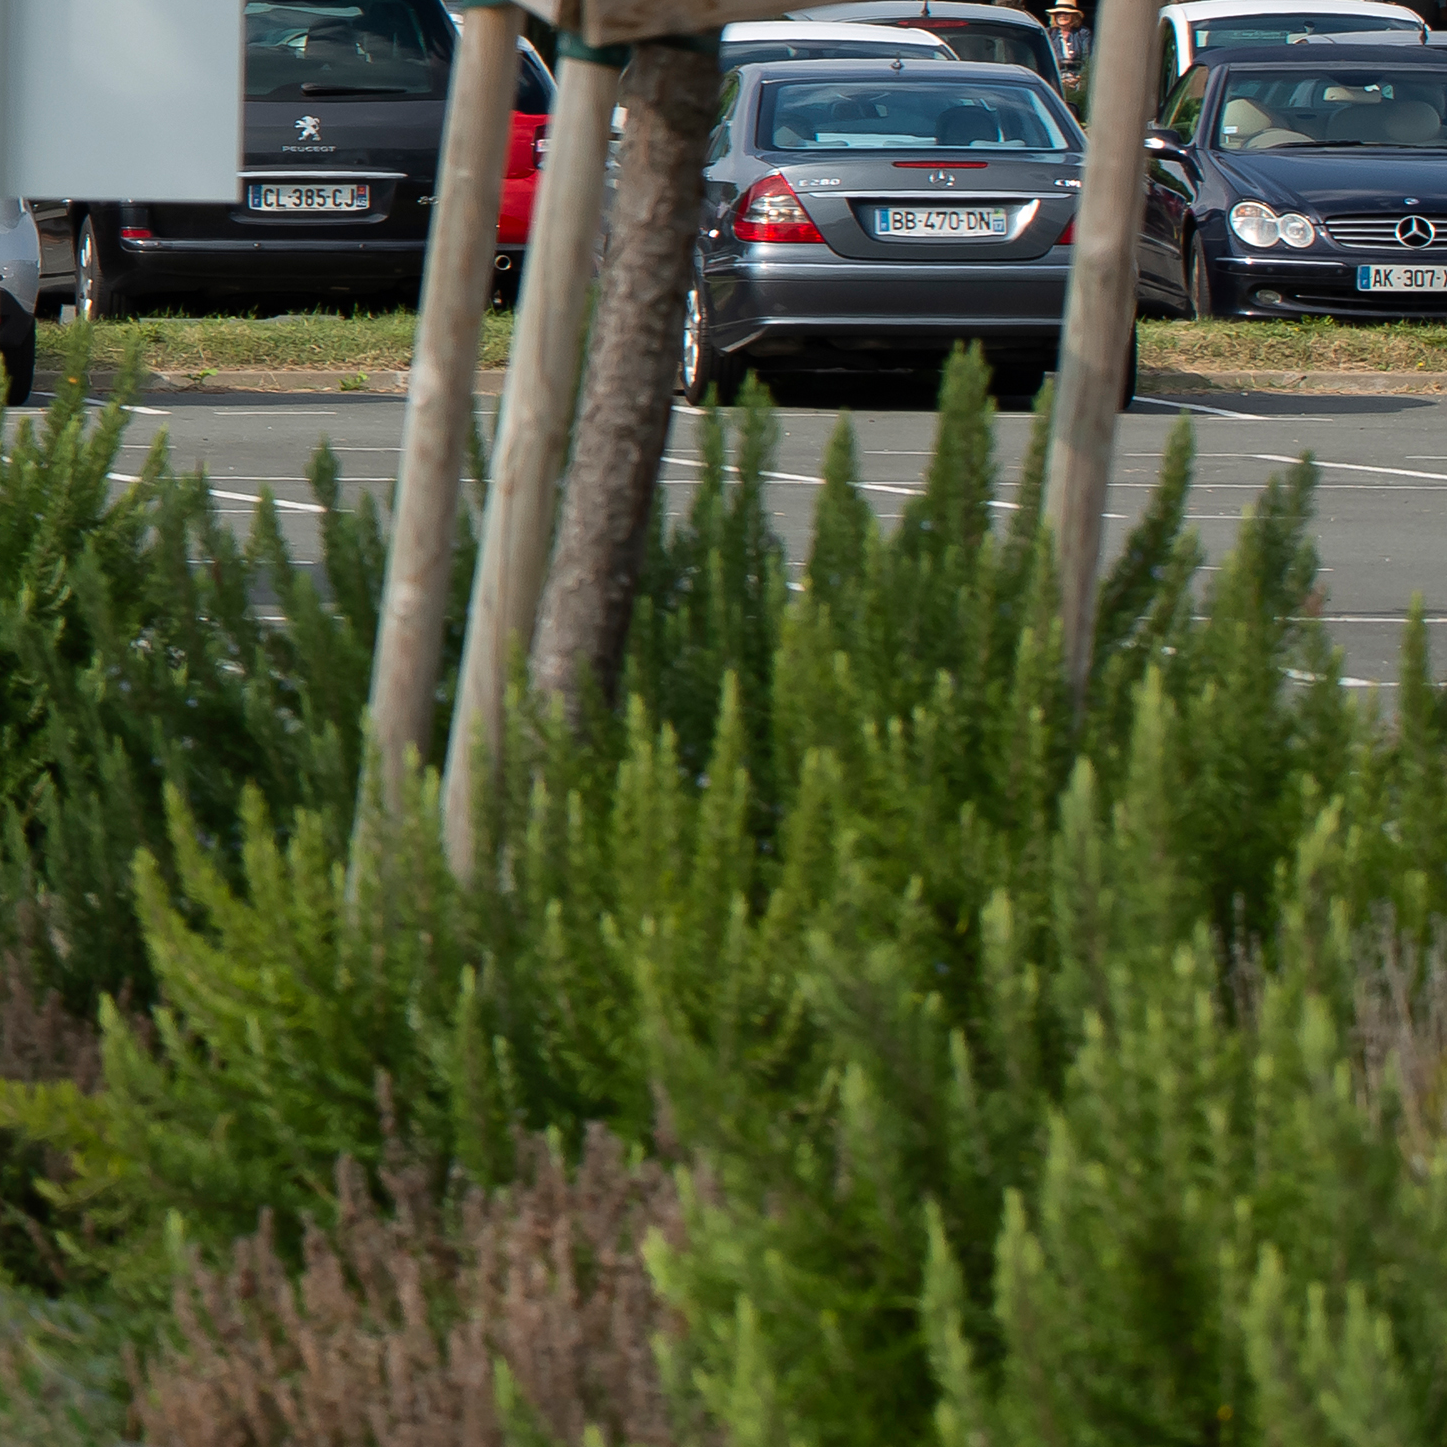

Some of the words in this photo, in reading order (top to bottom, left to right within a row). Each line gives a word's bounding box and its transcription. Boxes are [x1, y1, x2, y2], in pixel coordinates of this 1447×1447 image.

[281, 145, 337, 153] PEUGEOT
[263, 188, 355, 208] CL-385-CJ
[891, 210, 991, 231] BB-470-DN
